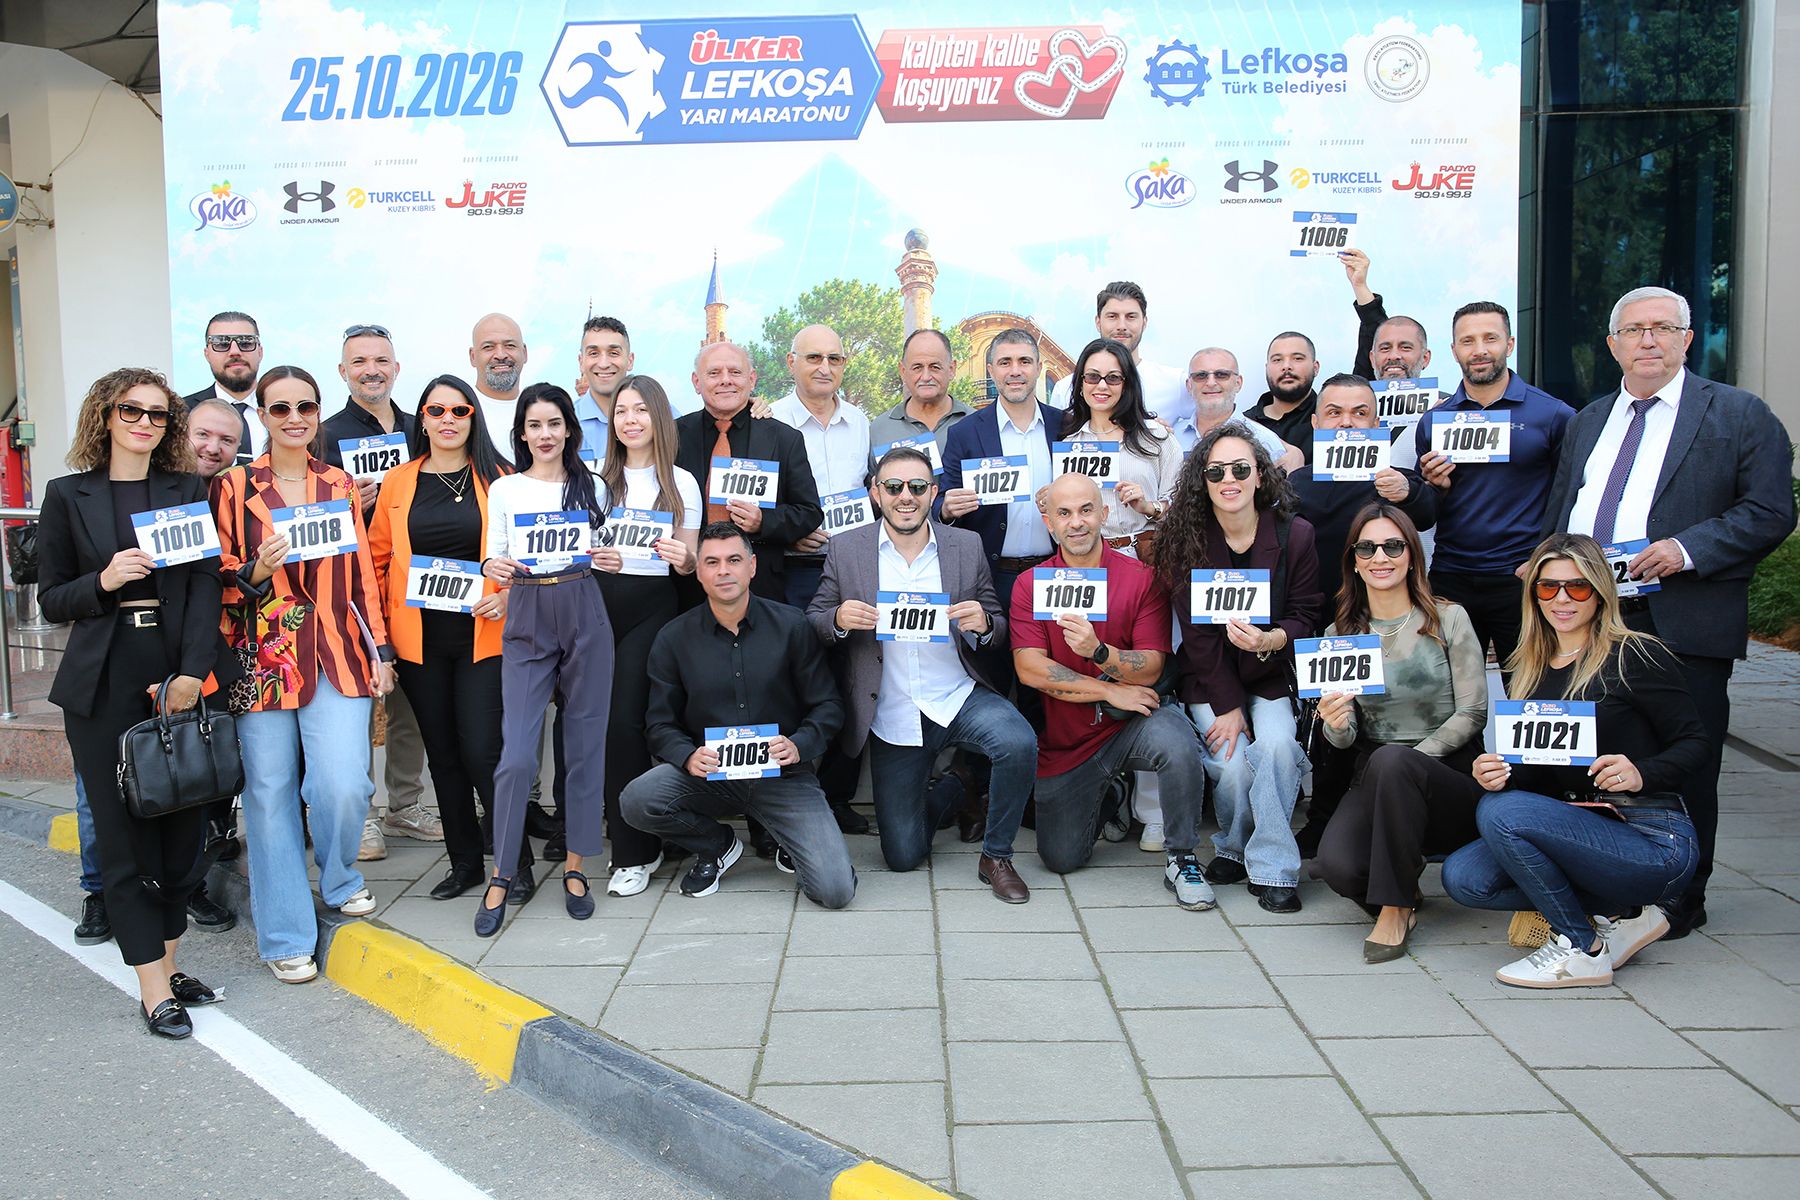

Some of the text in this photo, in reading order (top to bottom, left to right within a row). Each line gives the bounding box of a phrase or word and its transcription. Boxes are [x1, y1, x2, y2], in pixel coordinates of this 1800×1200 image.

[689, 29, 803, 63] ÜLKER
[900, 32, 1040, 74] kalpten kalbe
[1221, 47, 1348, 77] Lefkoşa
[281, 51, 523, 121] 25.10.2026
[680, 67, 854, 103] LEFKOŞA
[892, 73, 1003, 112] koşuyoruz
[1222, 79, 1347, 97] Türk Belediyesi
[679, 105, 850, 125] YARI MARATONU
[1312, 172, 1382, 184] TURKCELL
[368, 191, 435, 203] TURKCELL
[1414, 191, 1440, 199] 90.9
[467, 208, 492, 216] 90.9
[1300, 226, 1348, 247] 11006
[1378, 392, 1429, 416] 11005
[1443, 427, 1499, 451] 11004
[353, 449, 400, 474] 11023
[1062, 456, 1111, 477] 11028
[1326, 445, 1379, 469] 11016
[721, 472, 768, 497] 11013
[973, 470, 1019, 494] 11027
[151, 521, 204, 554] 11010
[289, 518, 341, 548] 11018
[526, 527, 580, 554] 11012
[611, 523, 663, 548] 11022
[418, 573, 474, 600] 11007
[1046, 585, 1095, 608] 11019
[1205, 587, 1257, 611] 11017
[890, 608, 936, 630] 11011
[1309, 654, 1371, 683] 11026
[1512, 721, 1580, 750] 11021
[717, 742, 769, 767] 11003
